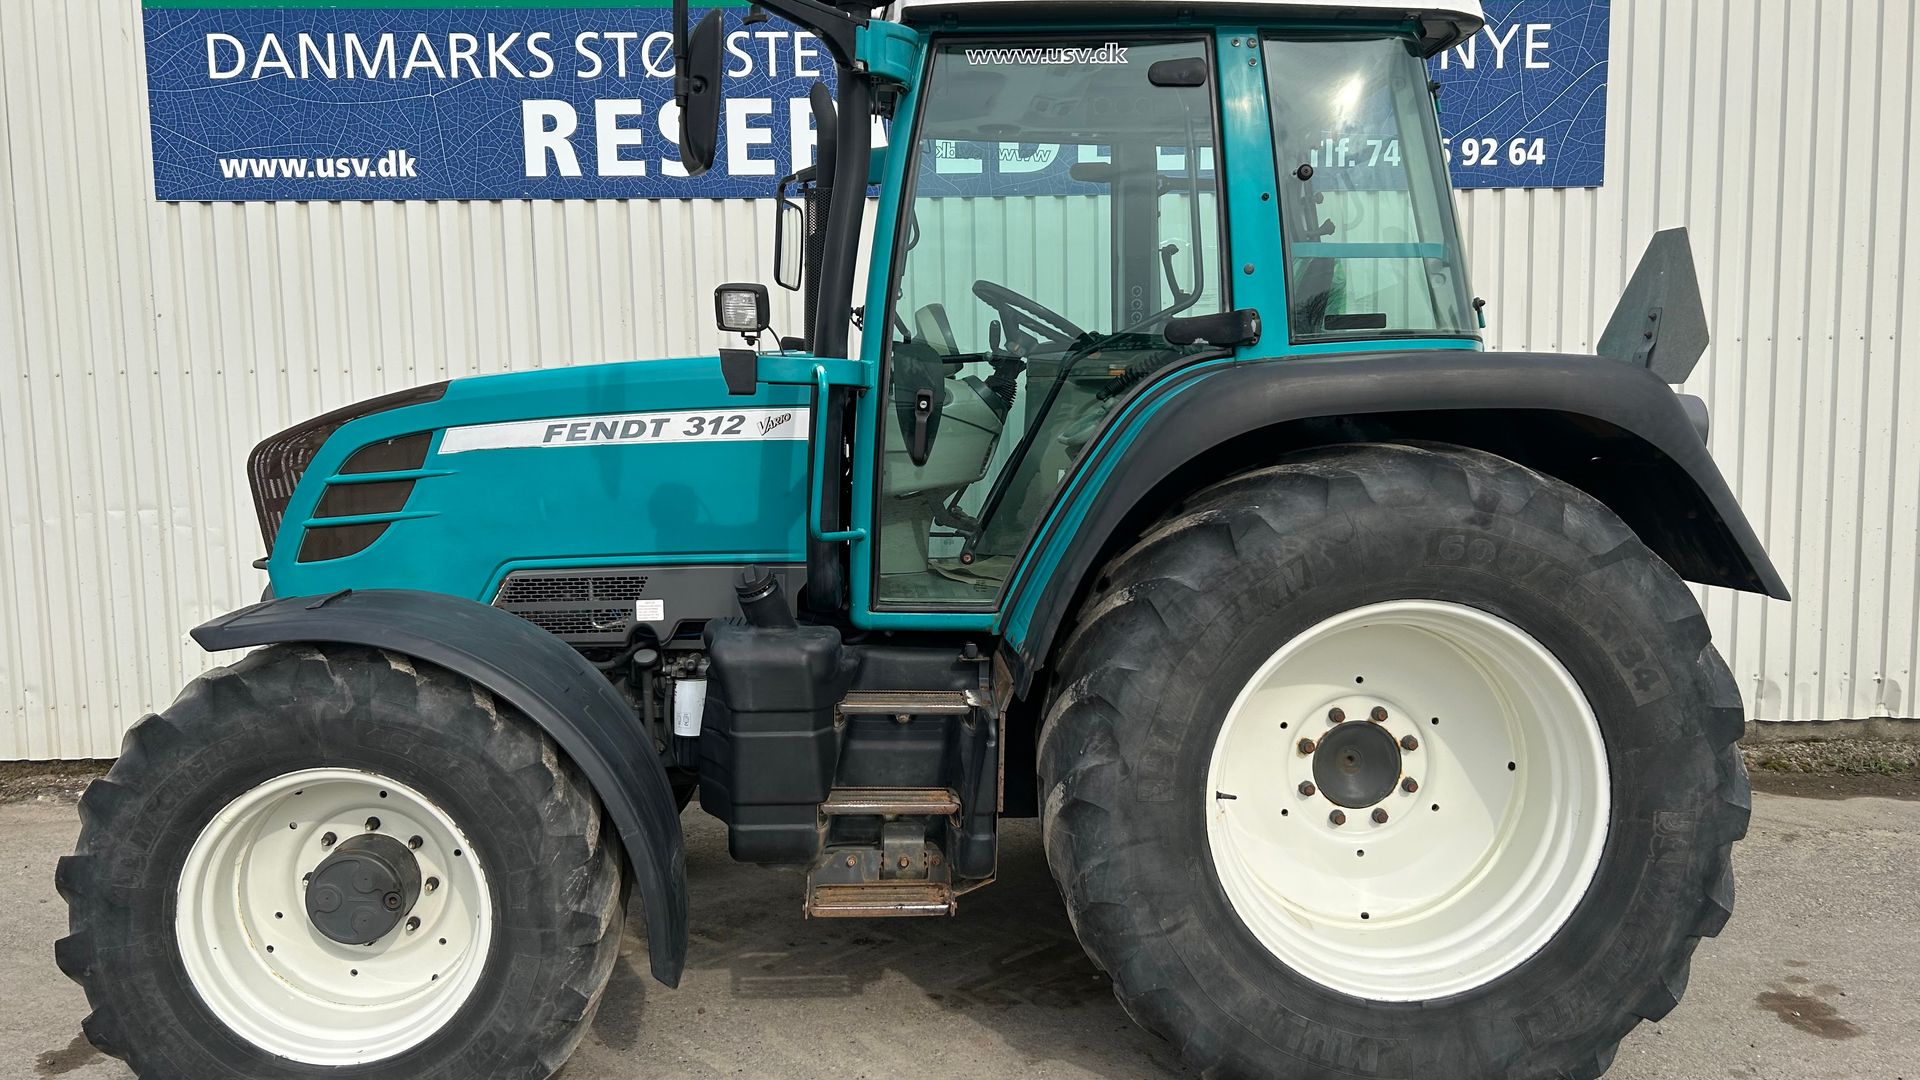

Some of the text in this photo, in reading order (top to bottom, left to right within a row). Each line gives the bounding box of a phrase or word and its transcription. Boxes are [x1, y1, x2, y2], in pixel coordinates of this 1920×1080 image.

[206, 32, 554, 79] DANMARKS
[575, 30, 820, 79] STØSTE
[965, 43, 1128, 65] www.usv.dk
[219, 149, 418, 179] www.usv.dk
[1461, 138, 1498, 166] 92
[1508, 138, 1546, 166] 64
[542, 417, 671, 443] FENDT
[682, 414, 746, 437] 312
